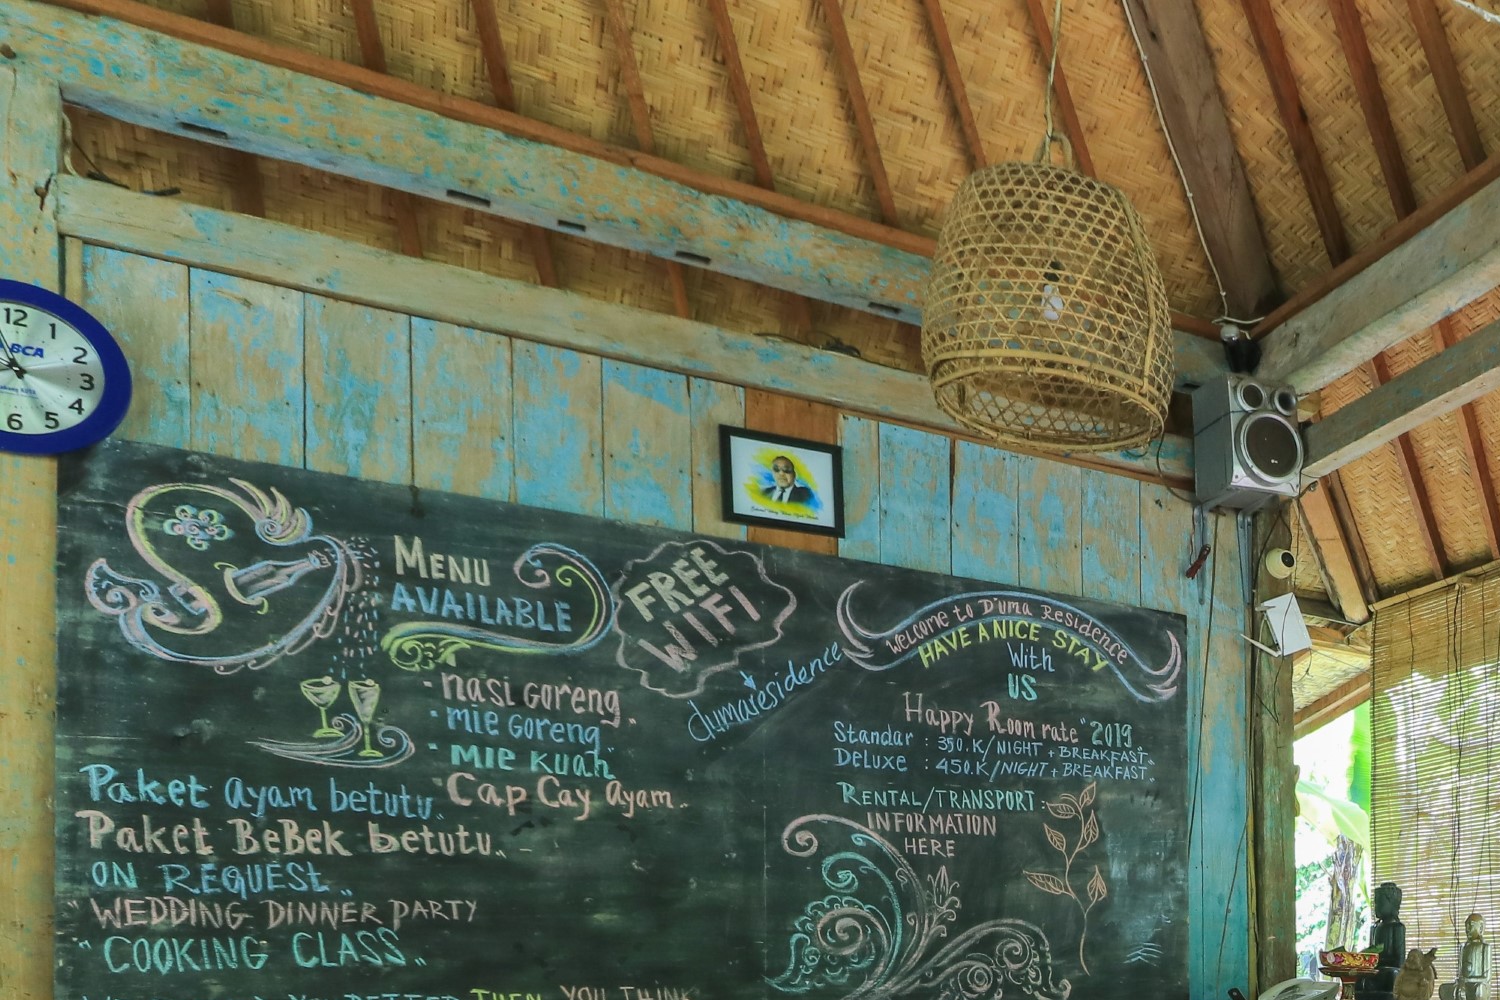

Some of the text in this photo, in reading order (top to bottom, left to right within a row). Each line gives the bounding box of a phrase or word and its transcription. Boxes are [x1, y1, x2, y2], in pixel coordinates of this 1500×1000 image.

[4, 307, 28, 328] 12
[49, 322, 57, 340] 1
[11, 342, 44, 359] BCA
[72, 346, 88, 365] 2
[79, 373, 95, 391] 3
[6, 413, 23, 431] 6
[44, 411, 60, 430] 5
[68, 398, 85, 415] 4
[394, 534, 491, 587] MENU
[624, 546, 730, 622] FREE
[390, 582, 573, 633] AVAILABLE
[636, 587, 762, 674] WIFI
[917, 619, 1109, 673] HAVE A NICE STAY
[952, 603, 974, 622] to
[1040, 604, 1129, 665] Residence
[1006, 641, 1056, 673] With
[441, 671, 513, 708] nasi
[1007, 673, 1038, 702] US
[902, 691, 974, 736] Happy
[979, 700, 1036, 740] Room
[833, 720, 914, 747] Standar
[78, 763, 211, 809] Paket
[446, 771, 528, 817] Cap
[536, 774, 591, 821] Cay
[75, 809, 215, 857] Paket
[866, 811, 998, 837] INFORMATION
[904, 836, 956, 858] HERE
[91, 860, 139, 889] ON
[260, 899, 383, 931] DINNER
[388, 898, 478, 931] PARTY
[291, 926, 407, 969] CLASS
